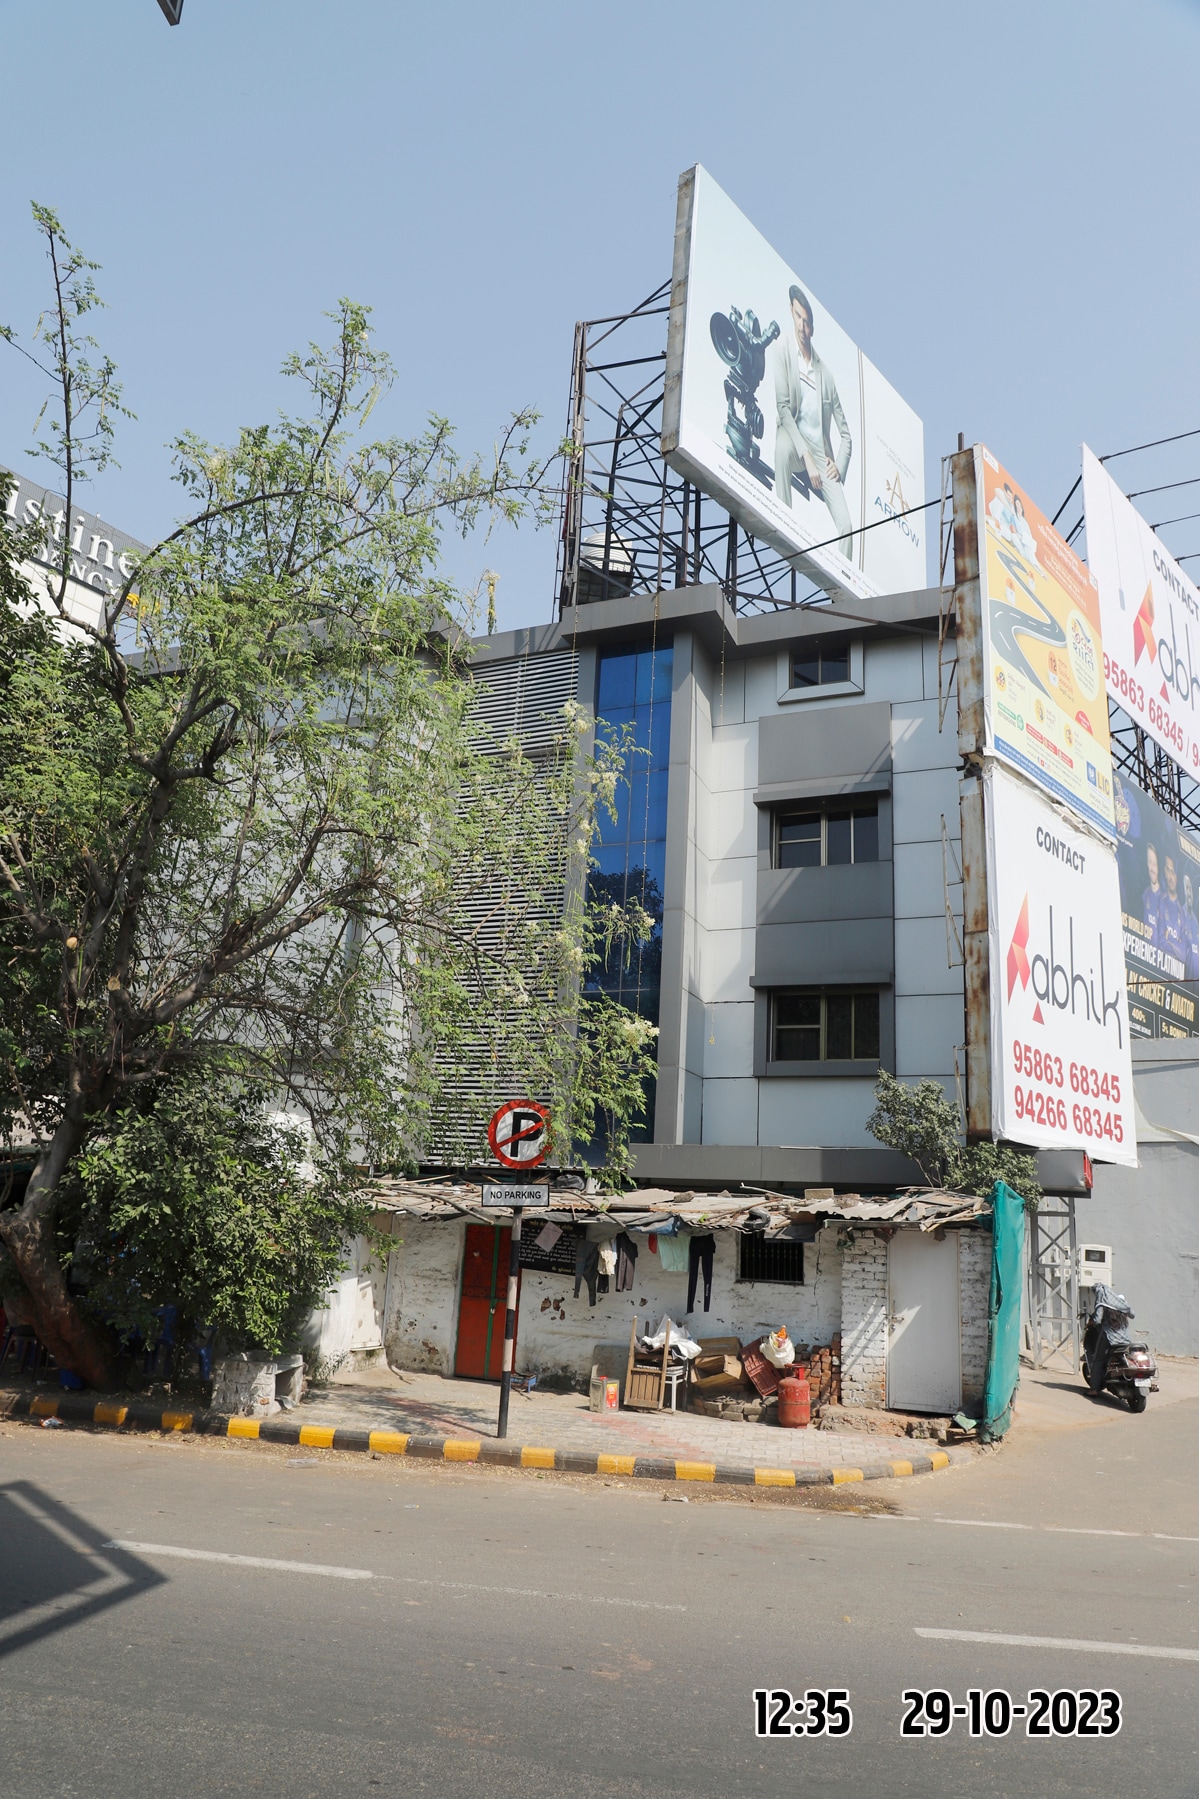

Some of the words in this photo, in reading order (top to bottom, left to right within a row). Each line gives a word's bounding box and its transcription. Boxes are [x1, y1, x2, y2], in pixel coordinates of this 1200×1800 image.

[874, 495, 920, 548] ARROW
[1153, 549, 1199, 622] CONTACT
[1103, 651, 1145, 713] 95863
[1149, 697, 1183, 752] 68345
[1097, 770, 1111, 799] LIC
[1036, 826, 1085, 875] CONTACT
[1128, 915, 1145, 936] WORLD
[1144, 924, 1153, 941] CUP
[1031, 905, 1122, 1050] abhik
[1156, 949, 1185, 981] PLATINUM
[1138, 975, 1165, 1008] CRICKET
[1164, 989, 1171, 1010] &
[1170, 991, 1195, 1022] AVIATOR
[1013, 1039, 1064, 1088] 95863
[1069, 1062, 1121, 1104] 68345
[1014, 1085, 1067, 1131] 94266
[1073, 1103, 1124, 1144] 68345
[490, 1191, 502, 1199] NO
[504, 1191, 542, 1199] PARKING
